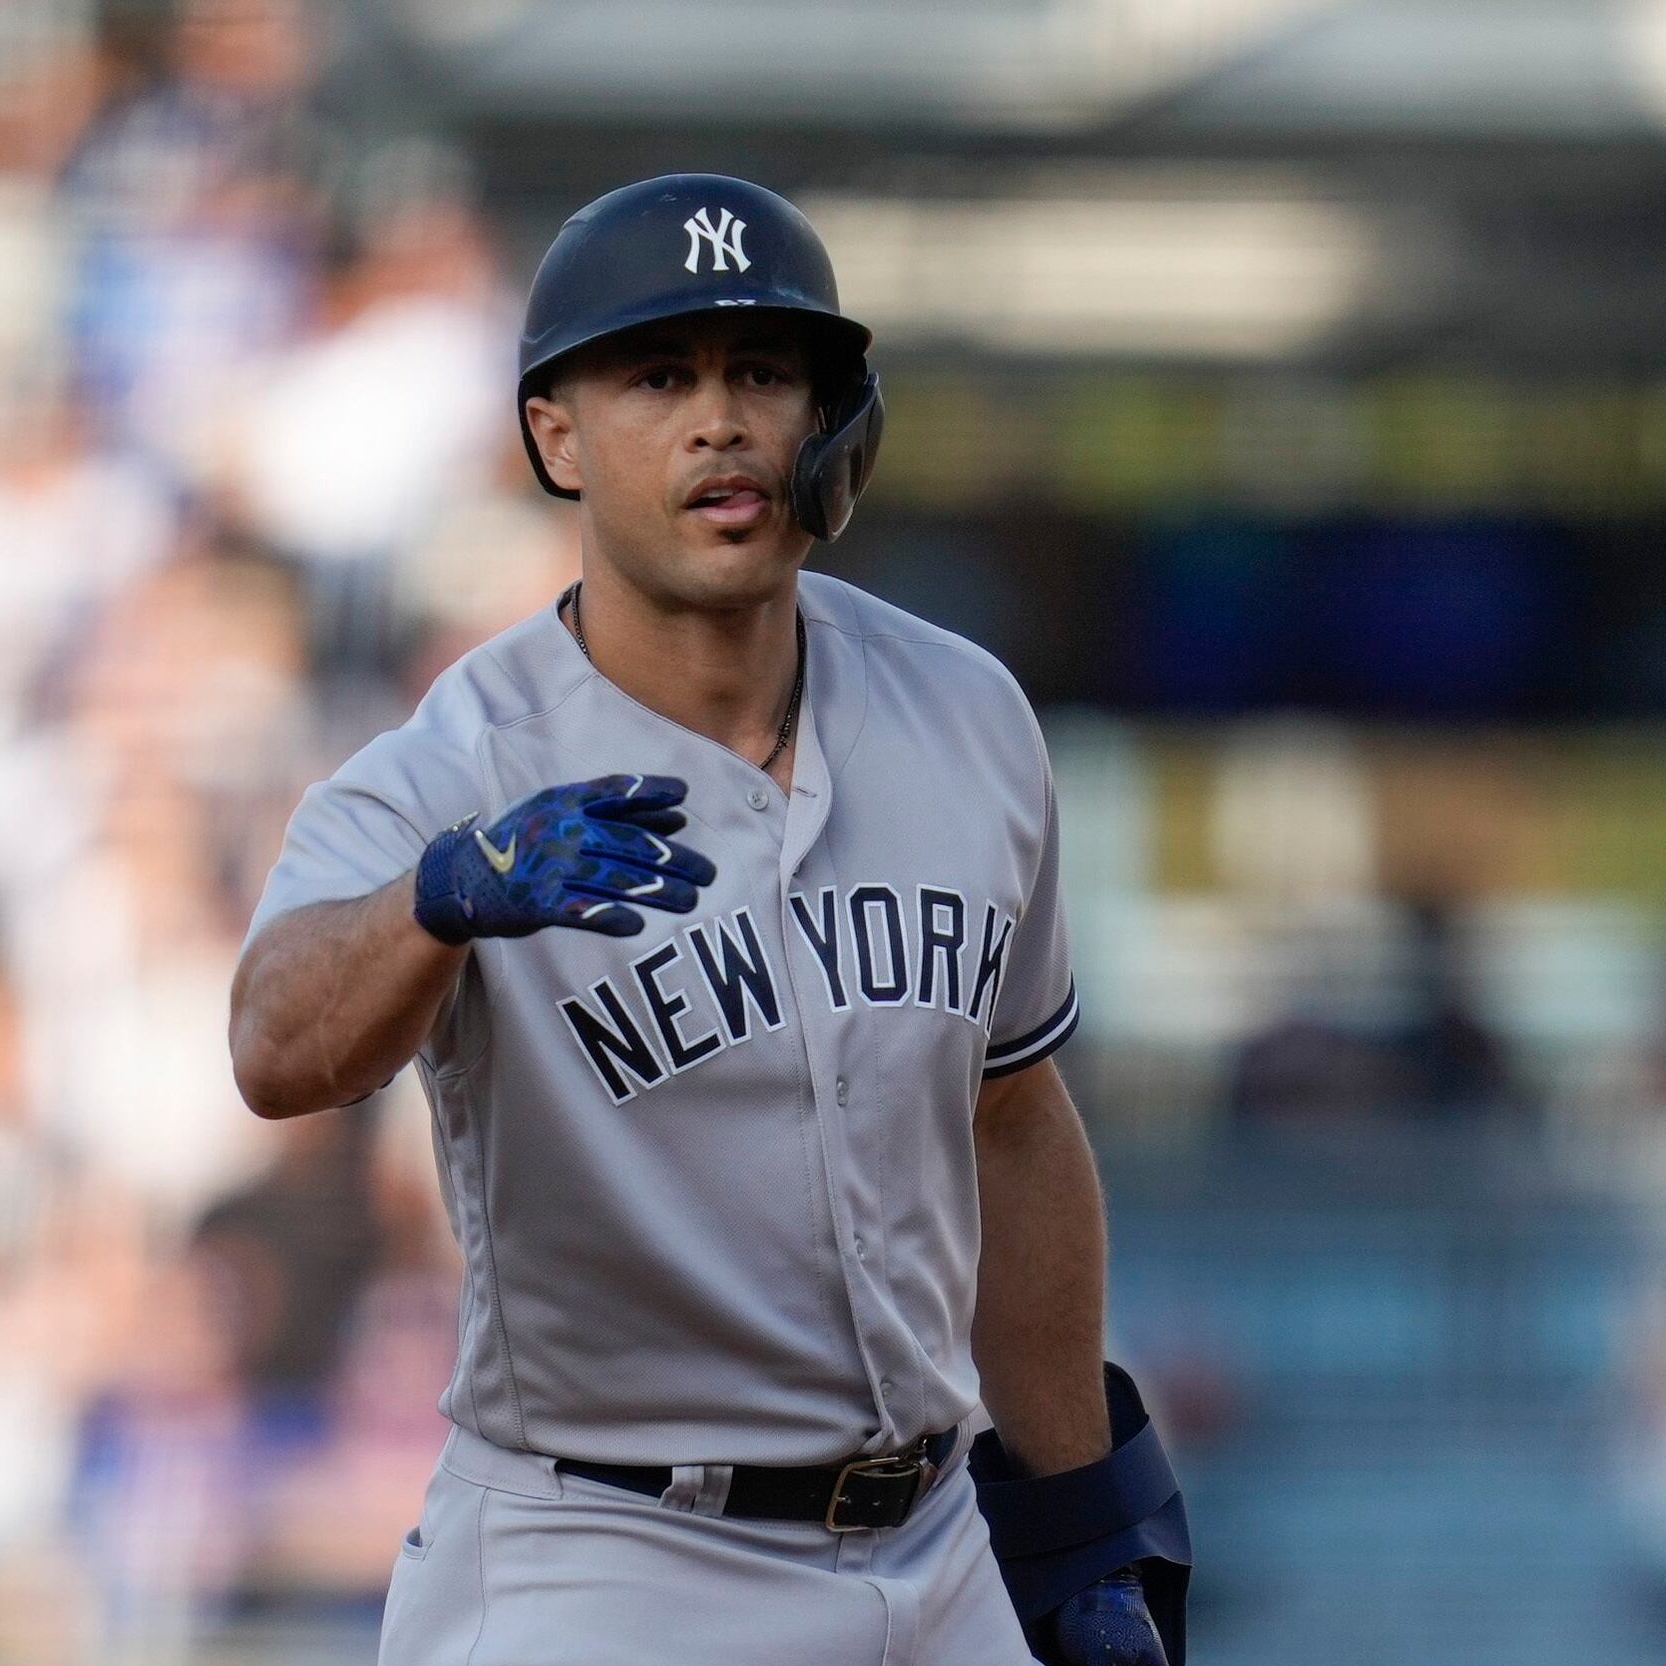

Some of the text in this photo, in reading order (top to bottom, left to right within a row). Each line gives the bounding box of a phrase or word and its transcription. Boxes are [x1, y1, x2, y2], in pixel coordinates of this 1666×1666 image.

[684, 207, 752, 274] NY
[556, 881, 1017, 1107] NEW YORK
